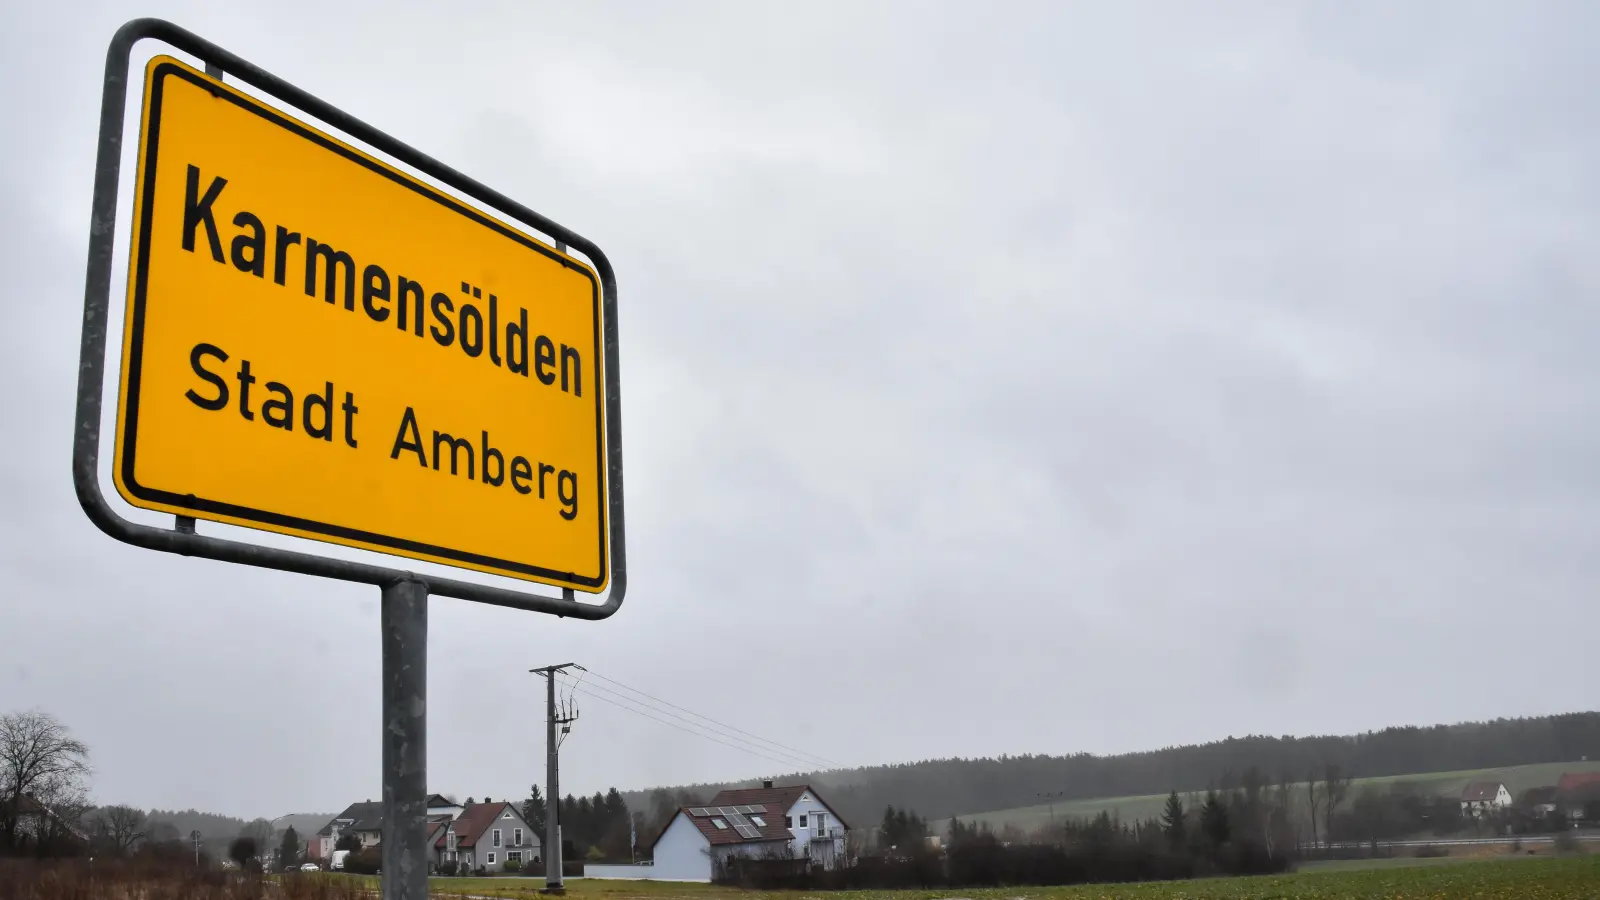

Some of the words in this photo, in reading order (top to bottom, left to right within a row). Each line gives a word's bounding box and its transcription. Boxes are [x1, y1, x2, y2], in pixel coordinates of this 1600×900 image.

[182, 164, 582, 398] Karmensölden
[185, 343, 359, 449] Stadt
[391, 406, 578, 521] Amberg
